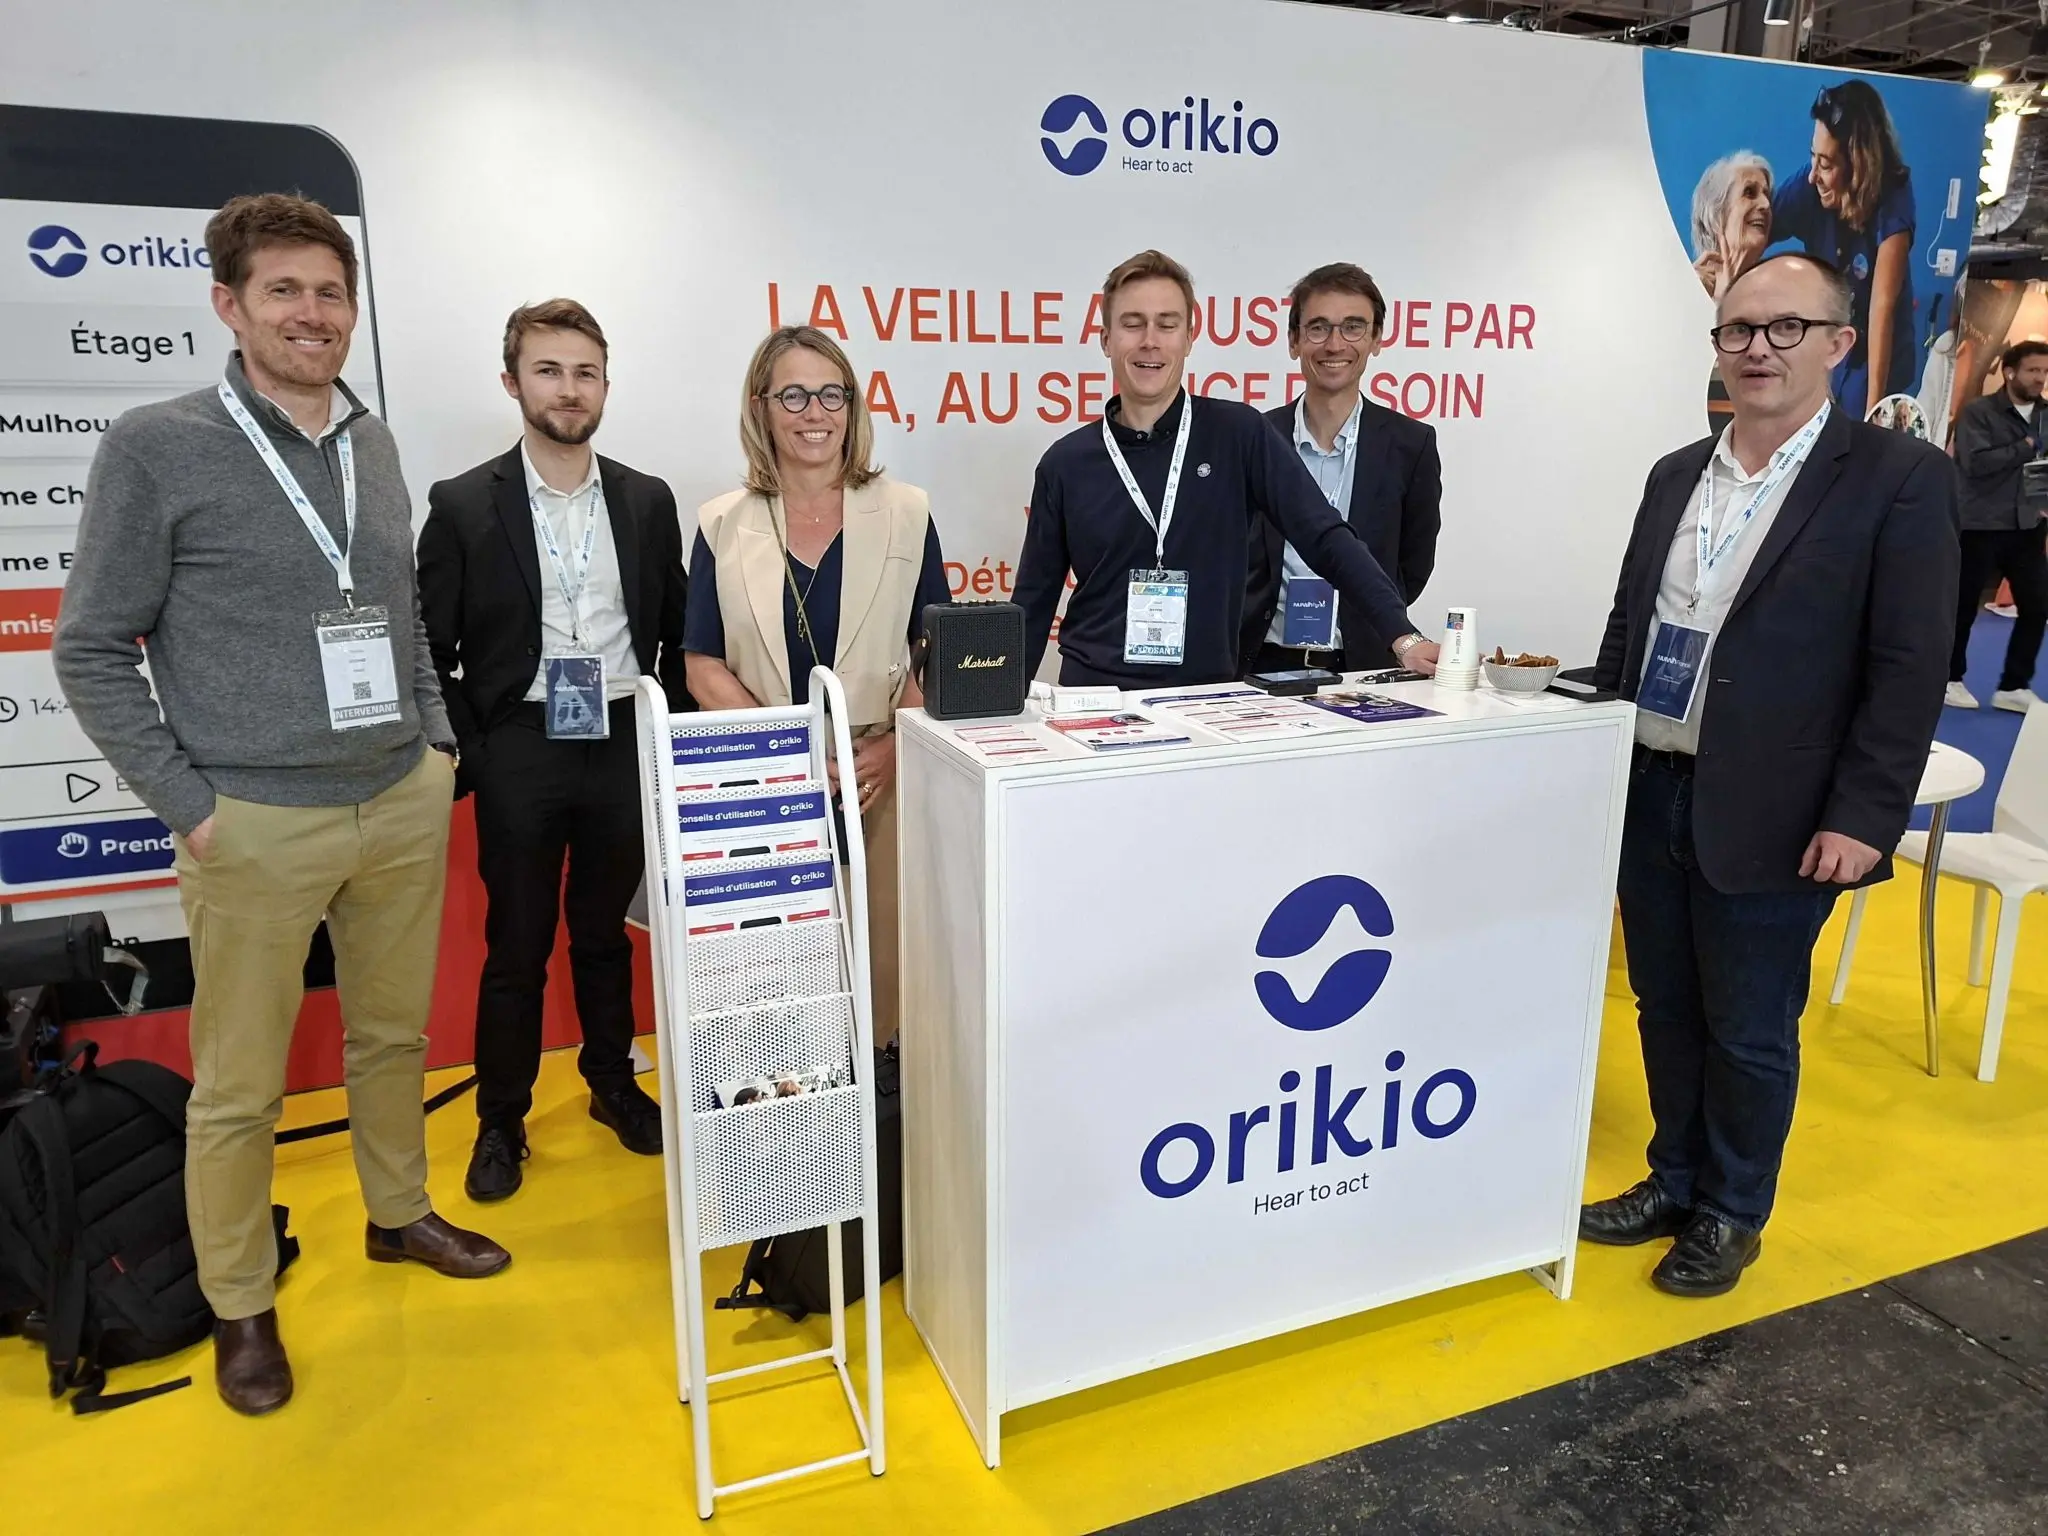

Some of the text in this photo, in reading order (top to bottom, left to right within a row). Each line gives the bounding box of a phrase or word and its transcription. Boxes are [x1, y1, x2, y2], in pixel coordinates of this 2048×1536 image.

[1122, 96, 1279, 156] orikio
[1122, 156, 1193, 173] Hear to act
[862, 286, 1064, 344] VEILLE
[1445, 303, 1536, 350] PAR
[71, 320, 195, 363] Étage 1
[936, 371, 1018, 424] AU
[1370, 372, 1484, 419] SOIN
[958, 655, 1006, 669] Marshall
[672, 748, 704, 757] onseils
[779, 736, 802, 745] orikio
[715, 808, 766, 820] d'utilisation
[791, 802, 814, 813] orikio
[101, 833, 174, 856] Prend
[686, 871, 825, 897] Conseils d'utilisation orikio
[1140, 1050, 1477, 1198] orikio
[1254, 1172, 1370, 1215] Hear to act
